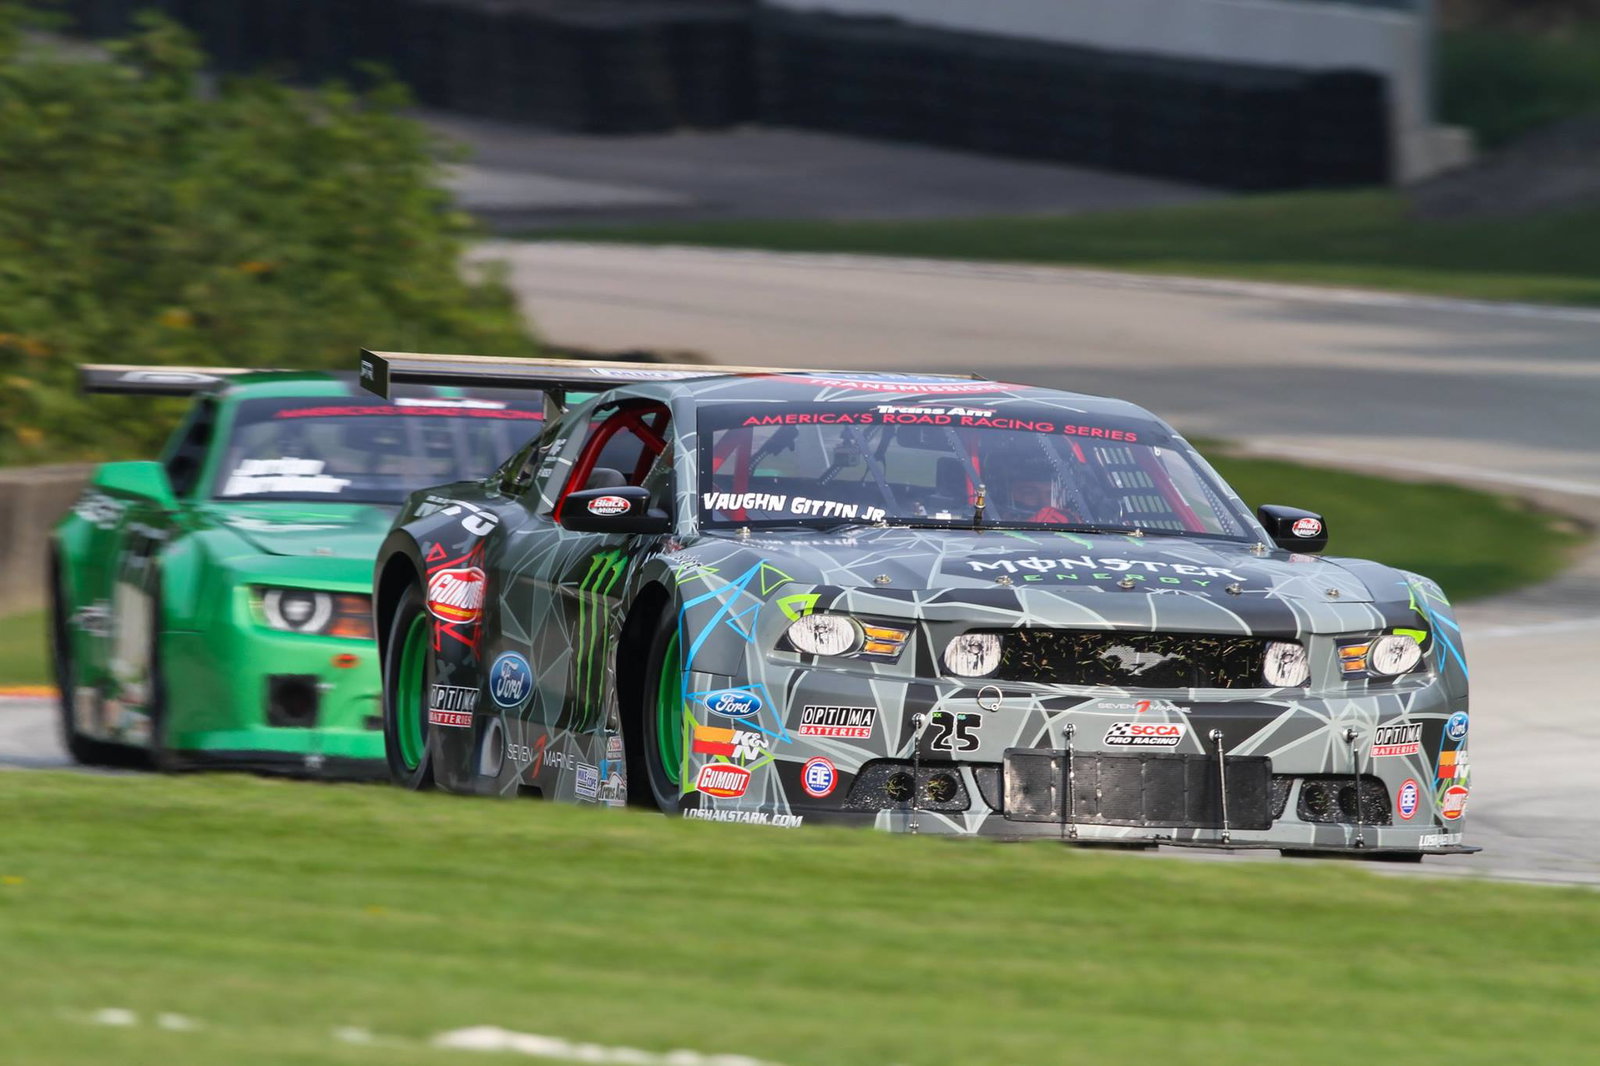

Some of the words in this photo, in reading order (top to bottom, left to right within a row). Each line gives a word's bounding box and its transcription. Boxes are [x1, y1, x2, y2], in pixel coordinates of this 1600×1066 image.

[876, 404, 944, 416] Trans
[947, 406, 993, 418] Am
[742, 413, 873, 426] AMERICA'S
[883, 413, 951, 425] ROAD
[961, 417, 1054, 432] RACING
[1063, 425, 1137, 442] SERIES
[702, 492, 787, 511] VAUGHN
[790, 497, 858, 518] GITTIN
[967, 556, 1248, 582] MONSTER
[1022, 572, 1211, 588] ENERGY
[496, 660, 524, 699] Ford
[715, 693, 753, 713] Ford
[802, 706, 875, 726] OPTIMA
[799, 725, 870, 737] BATTERIES
[930, 711, 983, 752] 25
[1106, 736, 1132, 744] PRO
[1132, 736, 1179, 745] RACING
[1130, 725, 1180, 736] SCCA
[700, 767, 749, 791] GUMOUT
